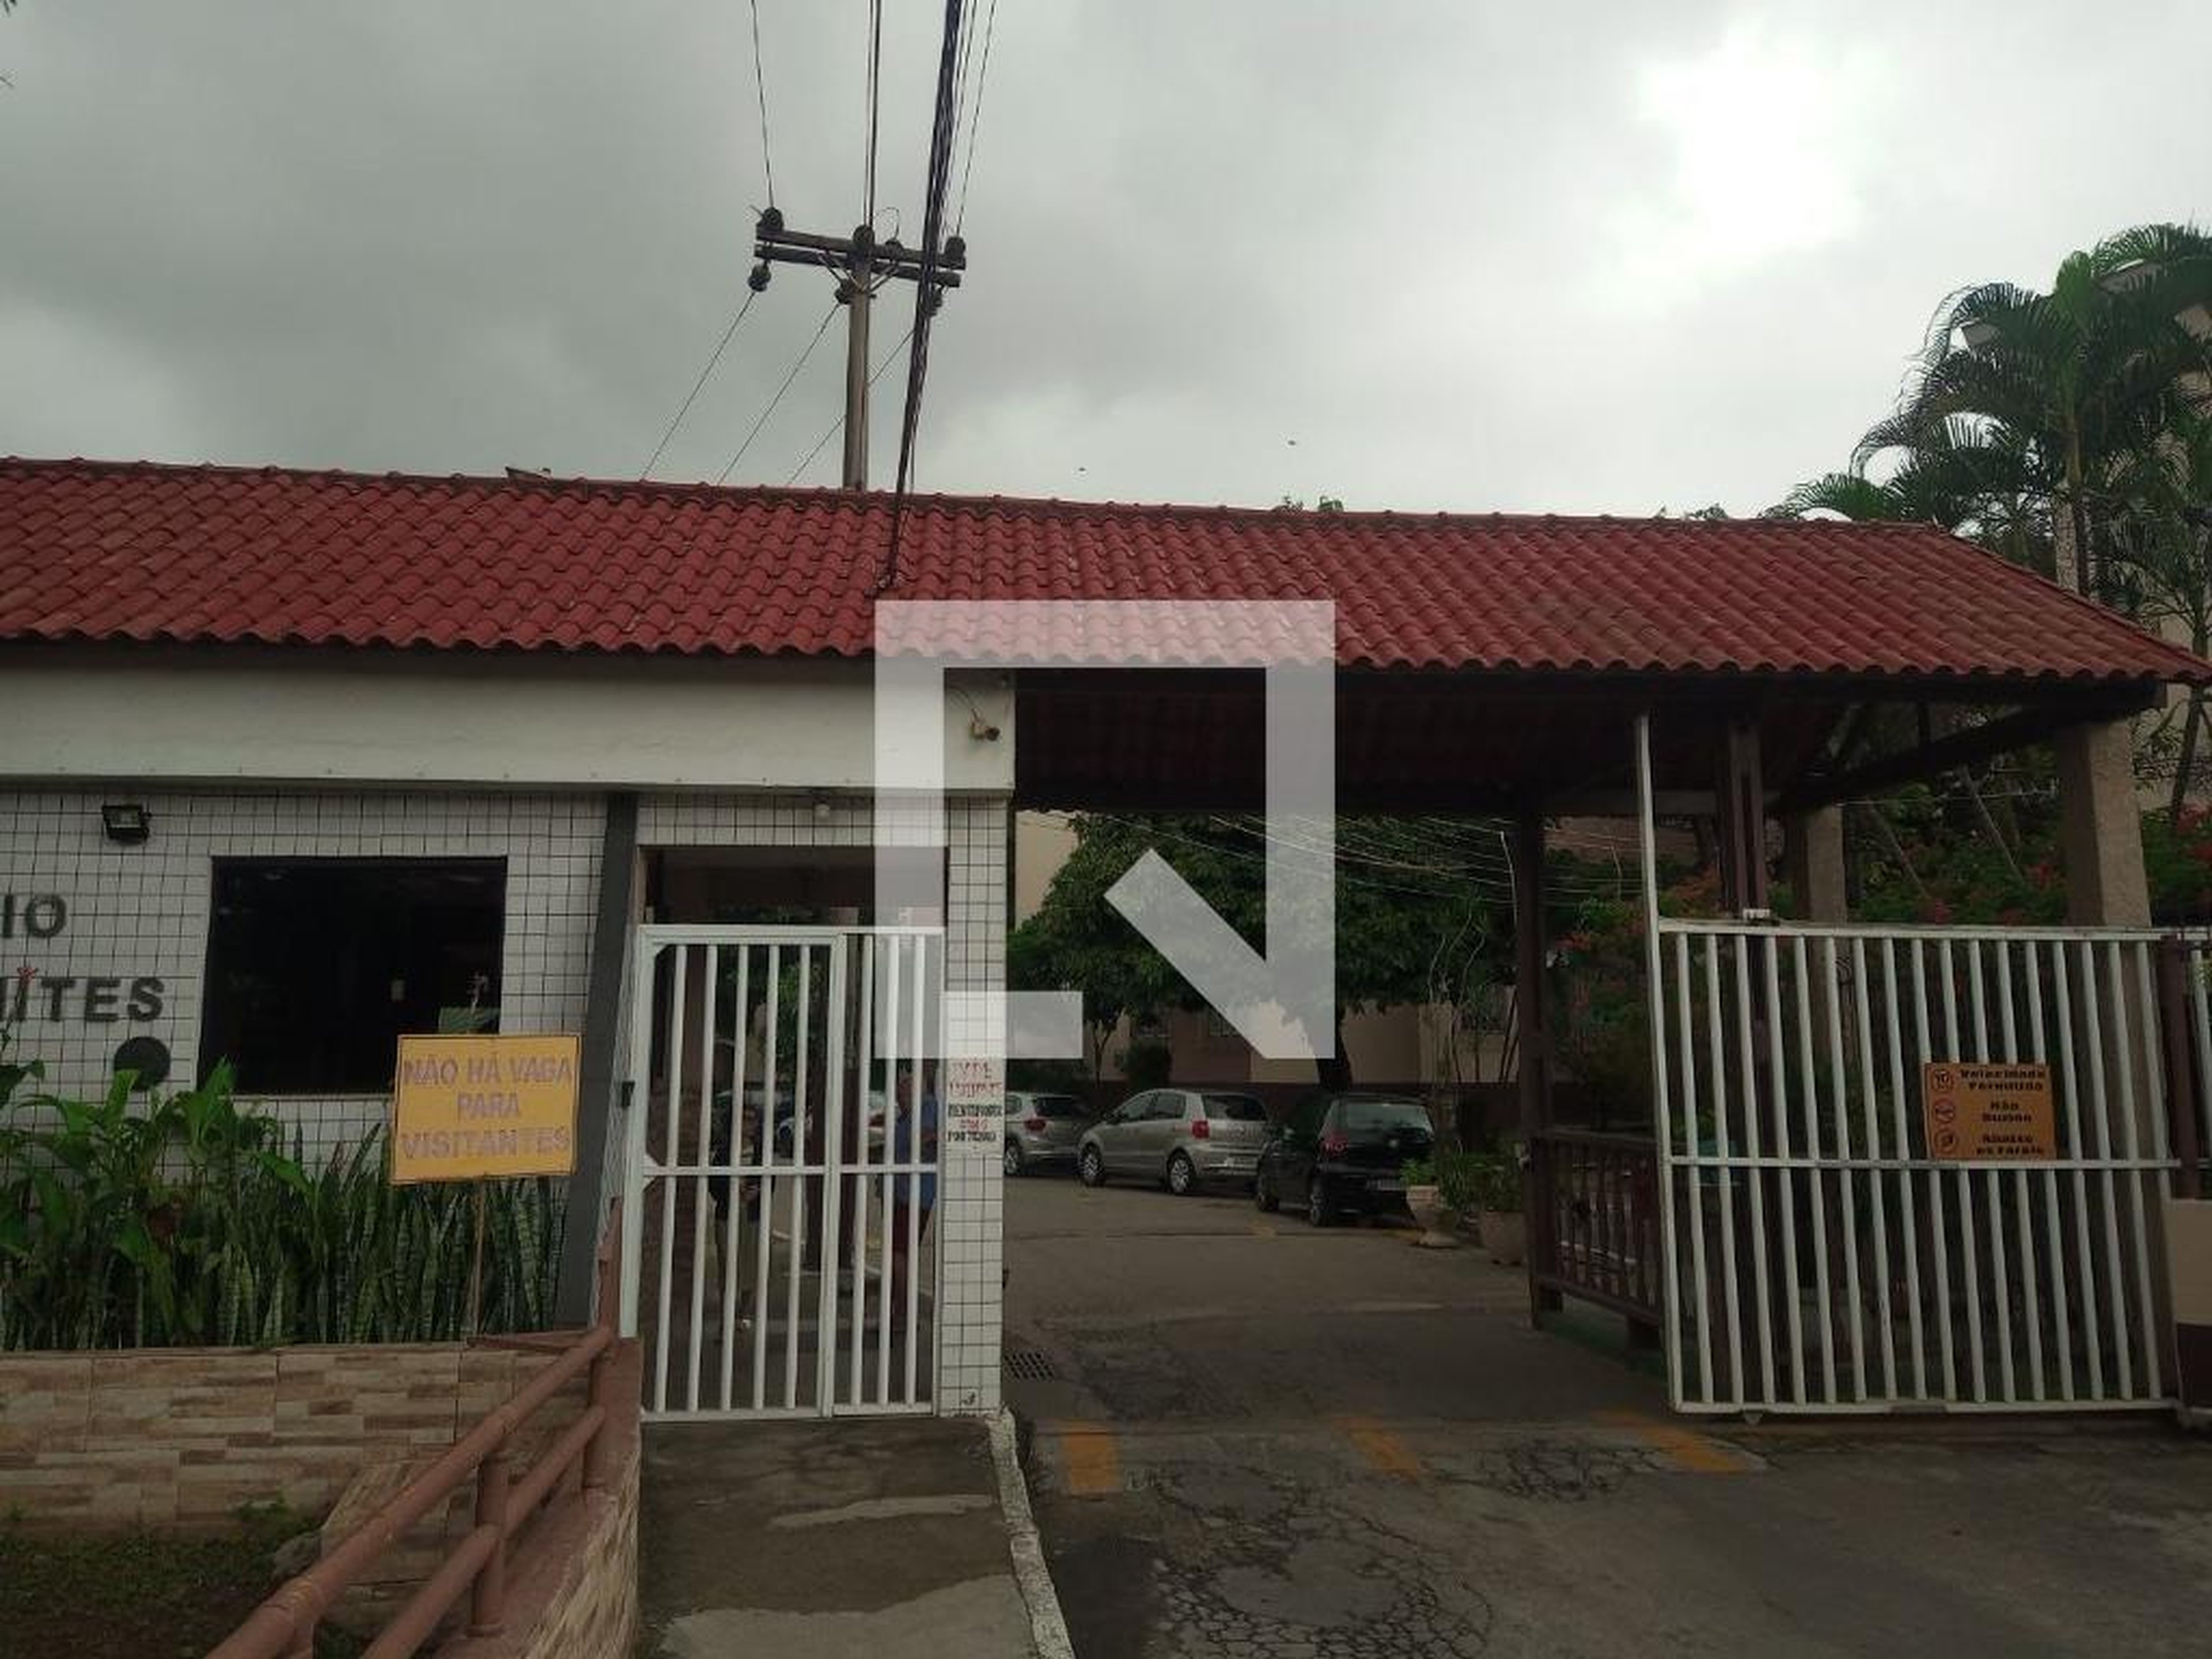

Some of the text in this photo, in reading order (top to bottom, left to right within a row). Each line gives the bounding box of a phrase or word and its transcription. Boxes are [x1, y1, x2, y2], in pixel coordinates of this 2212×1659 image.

[0, 978, 164, 1021] ITES
[403, 1054, 459, 1085] NÃO
[510, 1058, 572, 1083] VAGA
[458, 1093, 520, 1119] PARA
[402, 1127, 570, 1158] VISITANTES
